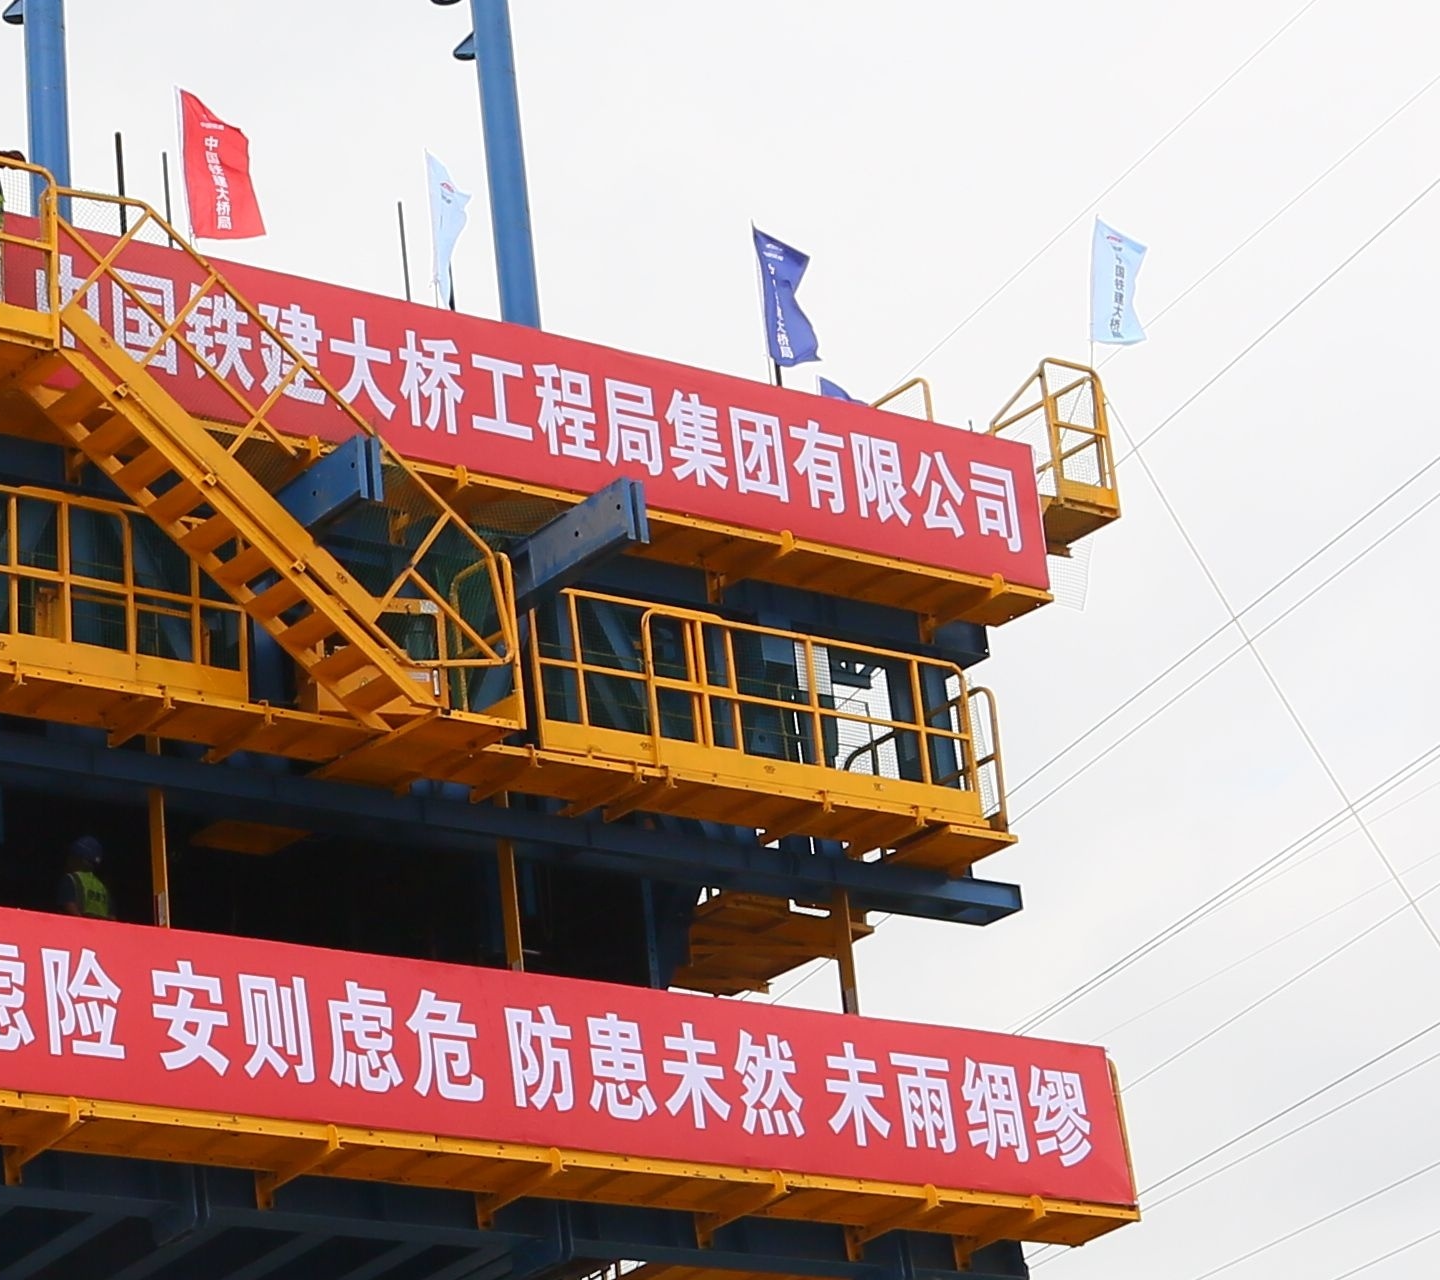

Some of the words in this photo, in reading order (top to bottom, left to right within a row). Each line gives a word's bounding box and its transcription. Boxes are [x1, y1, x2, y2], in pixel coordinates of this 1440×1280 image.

[35, 254, 1023, 554] 中国铁建大桥工程局集团有限公司
[151, 960, 485, 1104] 安则虑危
[504, 1004, 806, 1140] 防患未然
[826, 1041, 1092, 1168] 未雨绸缪
